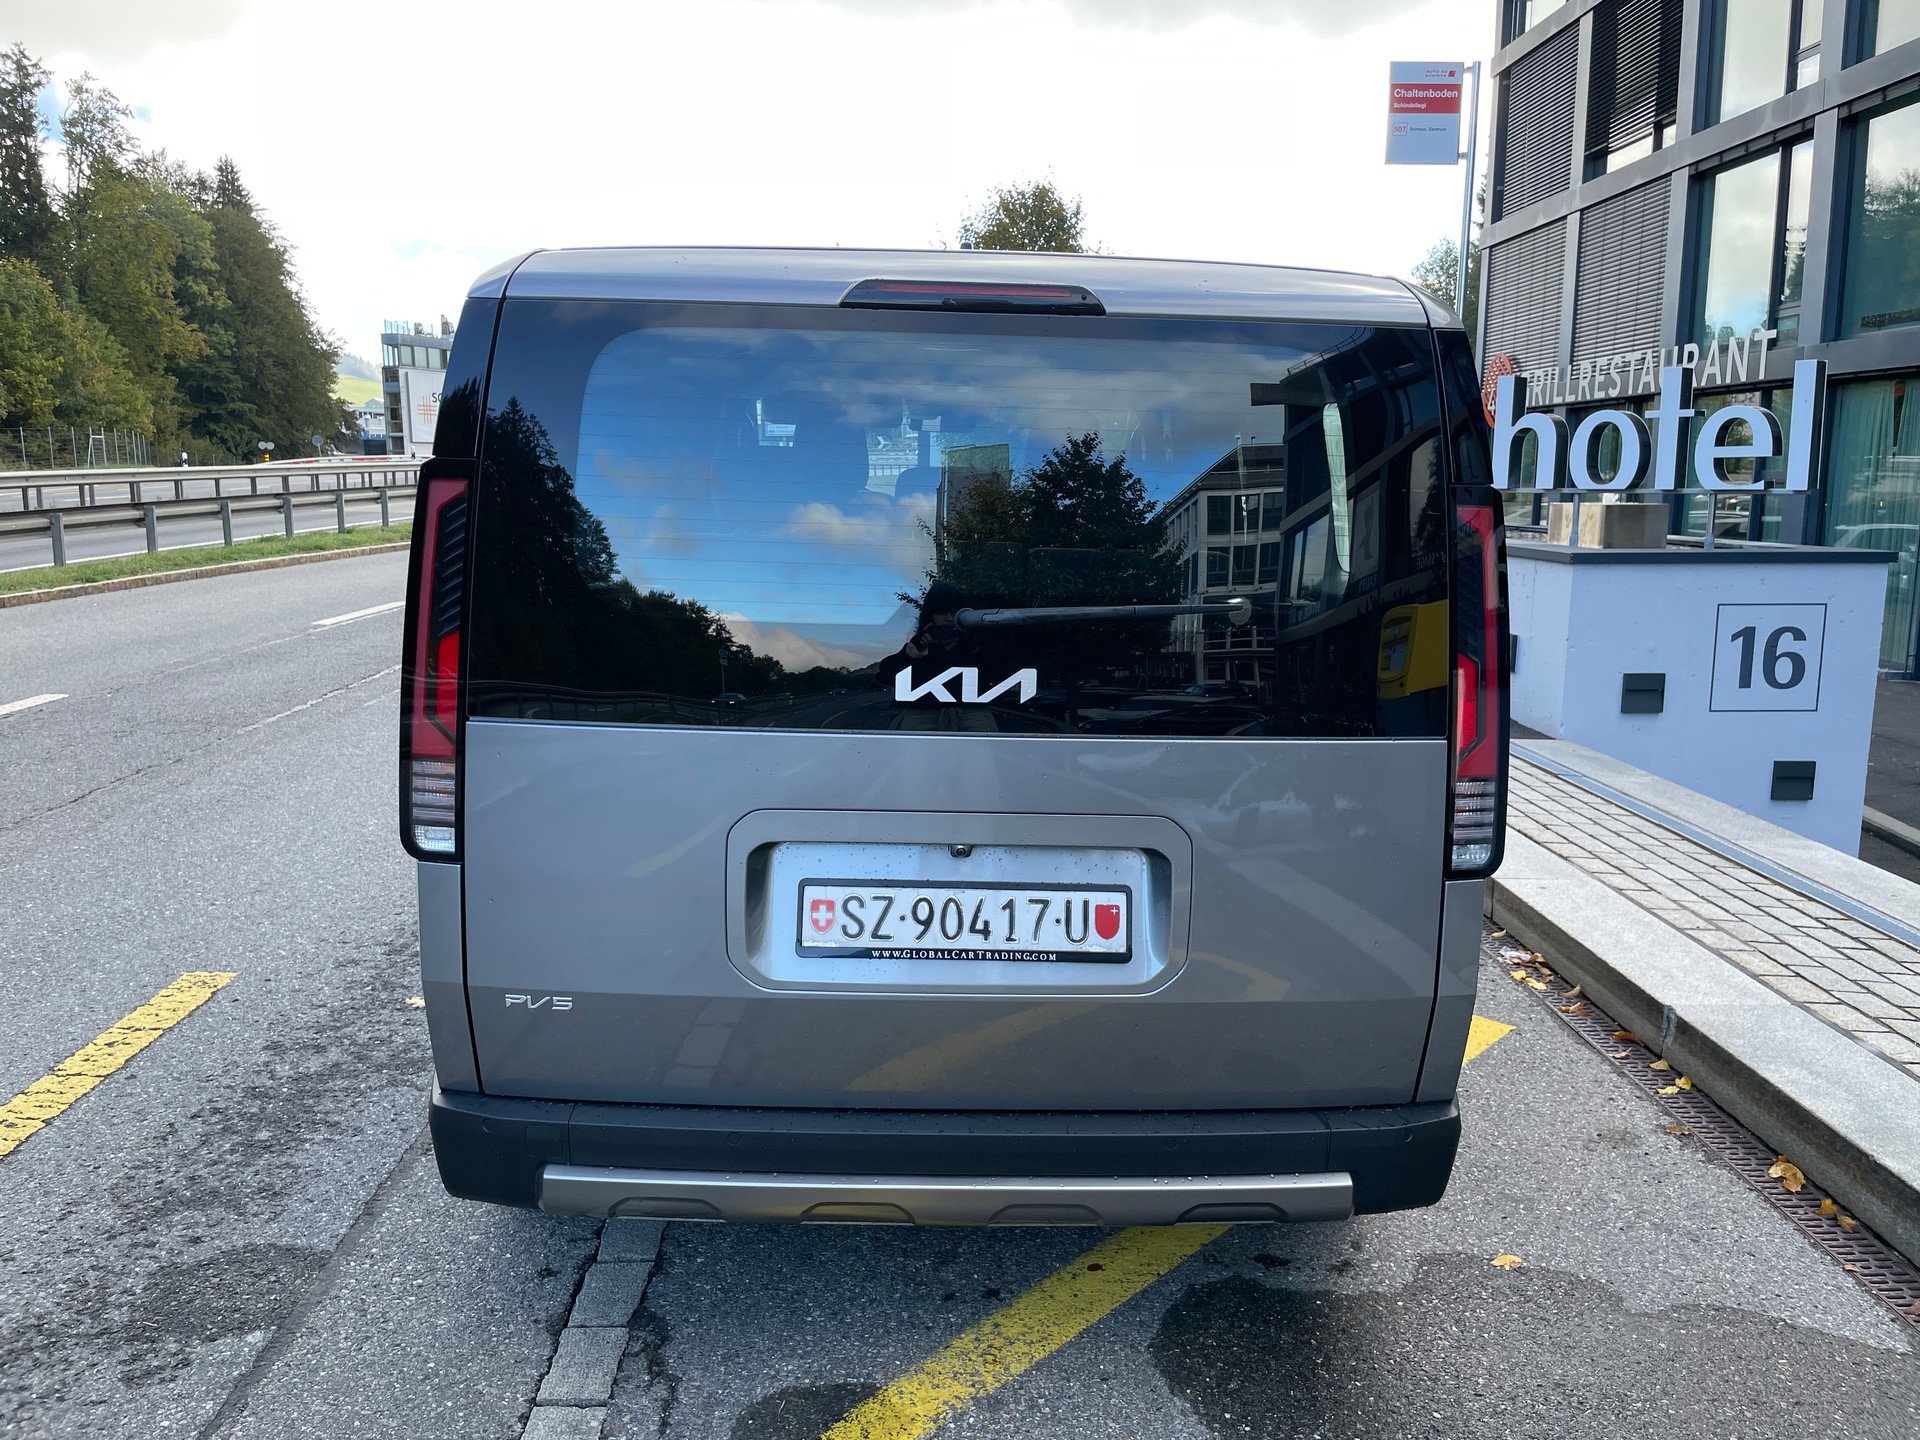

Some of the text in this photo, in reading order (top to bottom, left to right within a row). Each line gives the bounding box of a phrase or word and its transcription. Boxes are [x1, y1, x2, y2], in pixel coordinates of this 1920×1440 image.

[1394, 88, 1458, 98] Chaltenboden
[1492, 359, 1828, 490] hotel
[1731, 626, 1807, 690] 16
[895, 665, 1037, 704] KIA
[872, 950, 1057, 961] WWW.GLOBALCARTRADING.COM
[505, 994, 573, 1011] PV5
